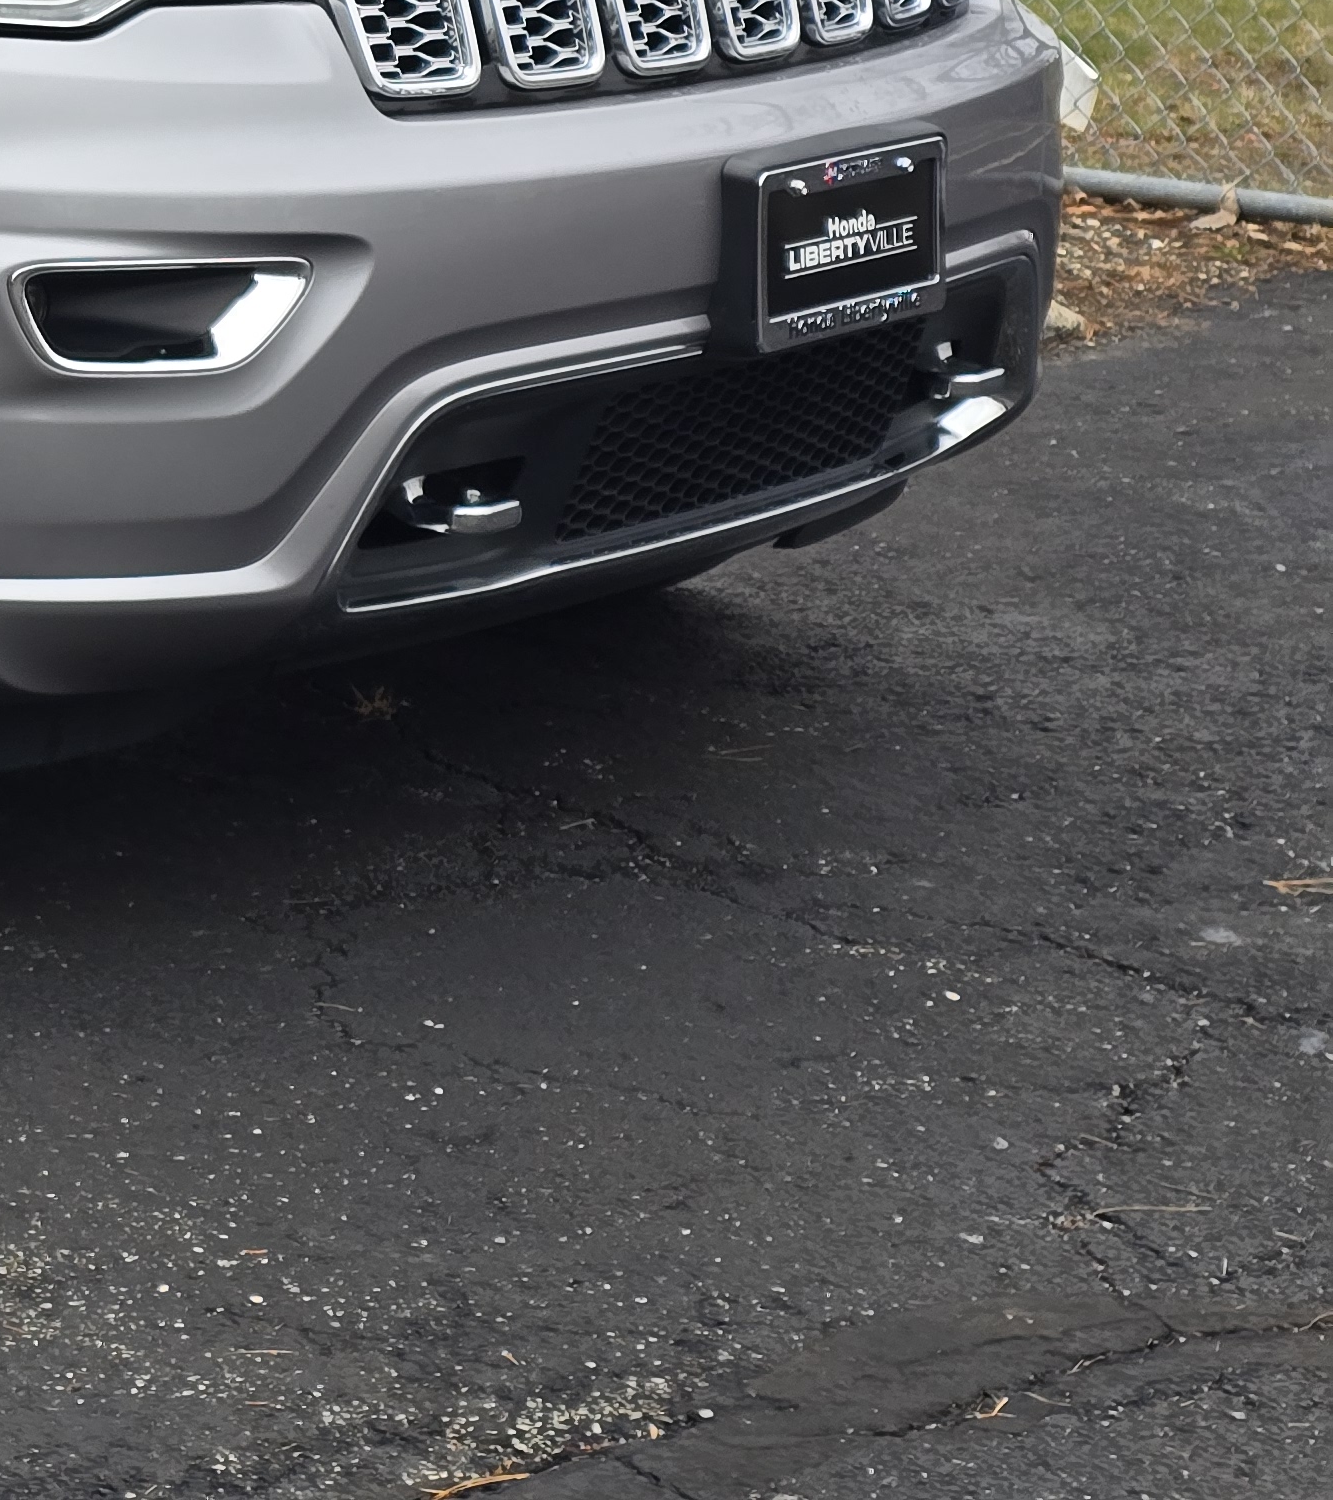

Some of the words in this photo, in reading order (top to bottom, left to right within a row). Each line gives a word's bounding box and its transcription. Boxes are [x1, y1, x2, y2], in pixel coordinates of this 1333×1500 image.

[829, 208, 876, 238] Honda
[789, 224, 914, 271] LIBERTYVILLE
[786, 308, 837, 339] Honda
[839, 289, 921, 326] Libertyville
